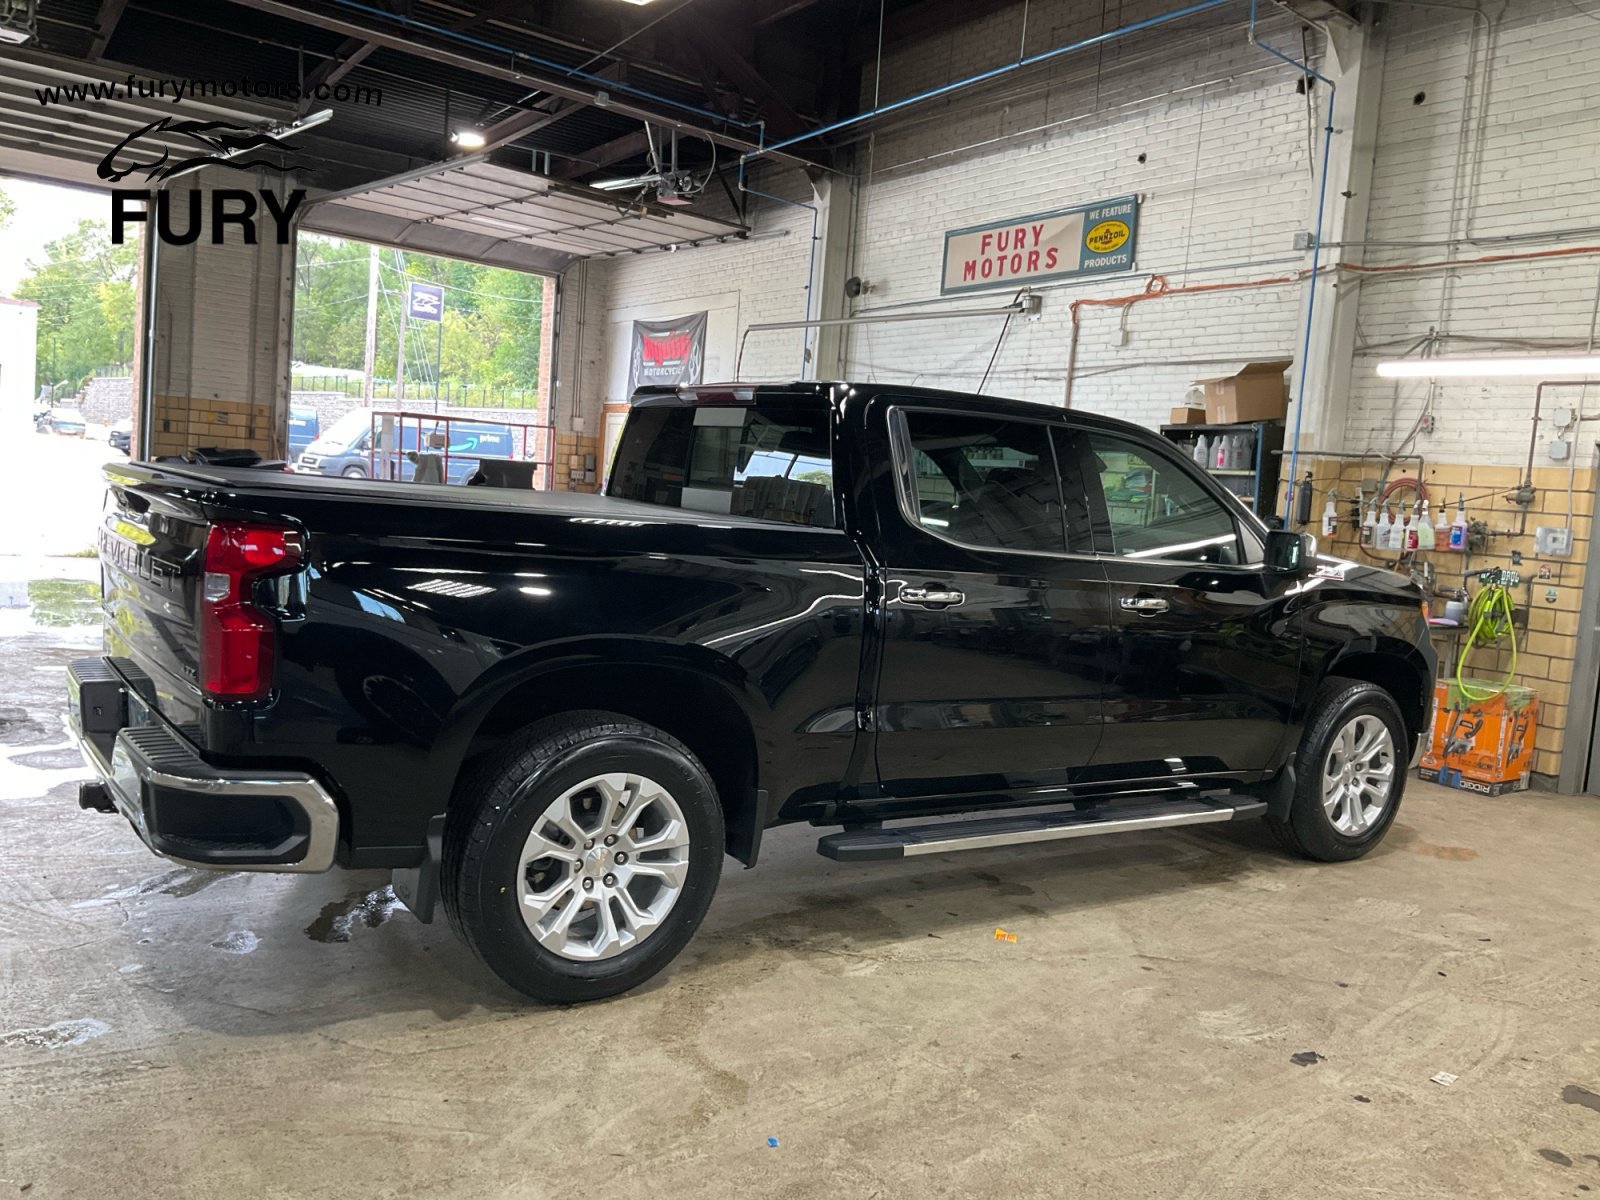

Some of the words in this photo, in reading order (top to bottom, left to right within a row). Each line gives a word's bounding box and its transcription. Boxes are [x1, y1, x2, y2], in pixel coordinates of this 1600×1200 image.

[1089, 210, 1100, 220] WE
[1101, 204, 1132, 218] FEATURE
[981, 224, 1044, 255] FURY
[1089, 230, 1126, 245] PENNZOIL
[963, 247, 1058, 282] MOTORS
[1084, 254, 1127, 269] PRODUCTS
[1459, 780, 1491, 794] RIDGID
